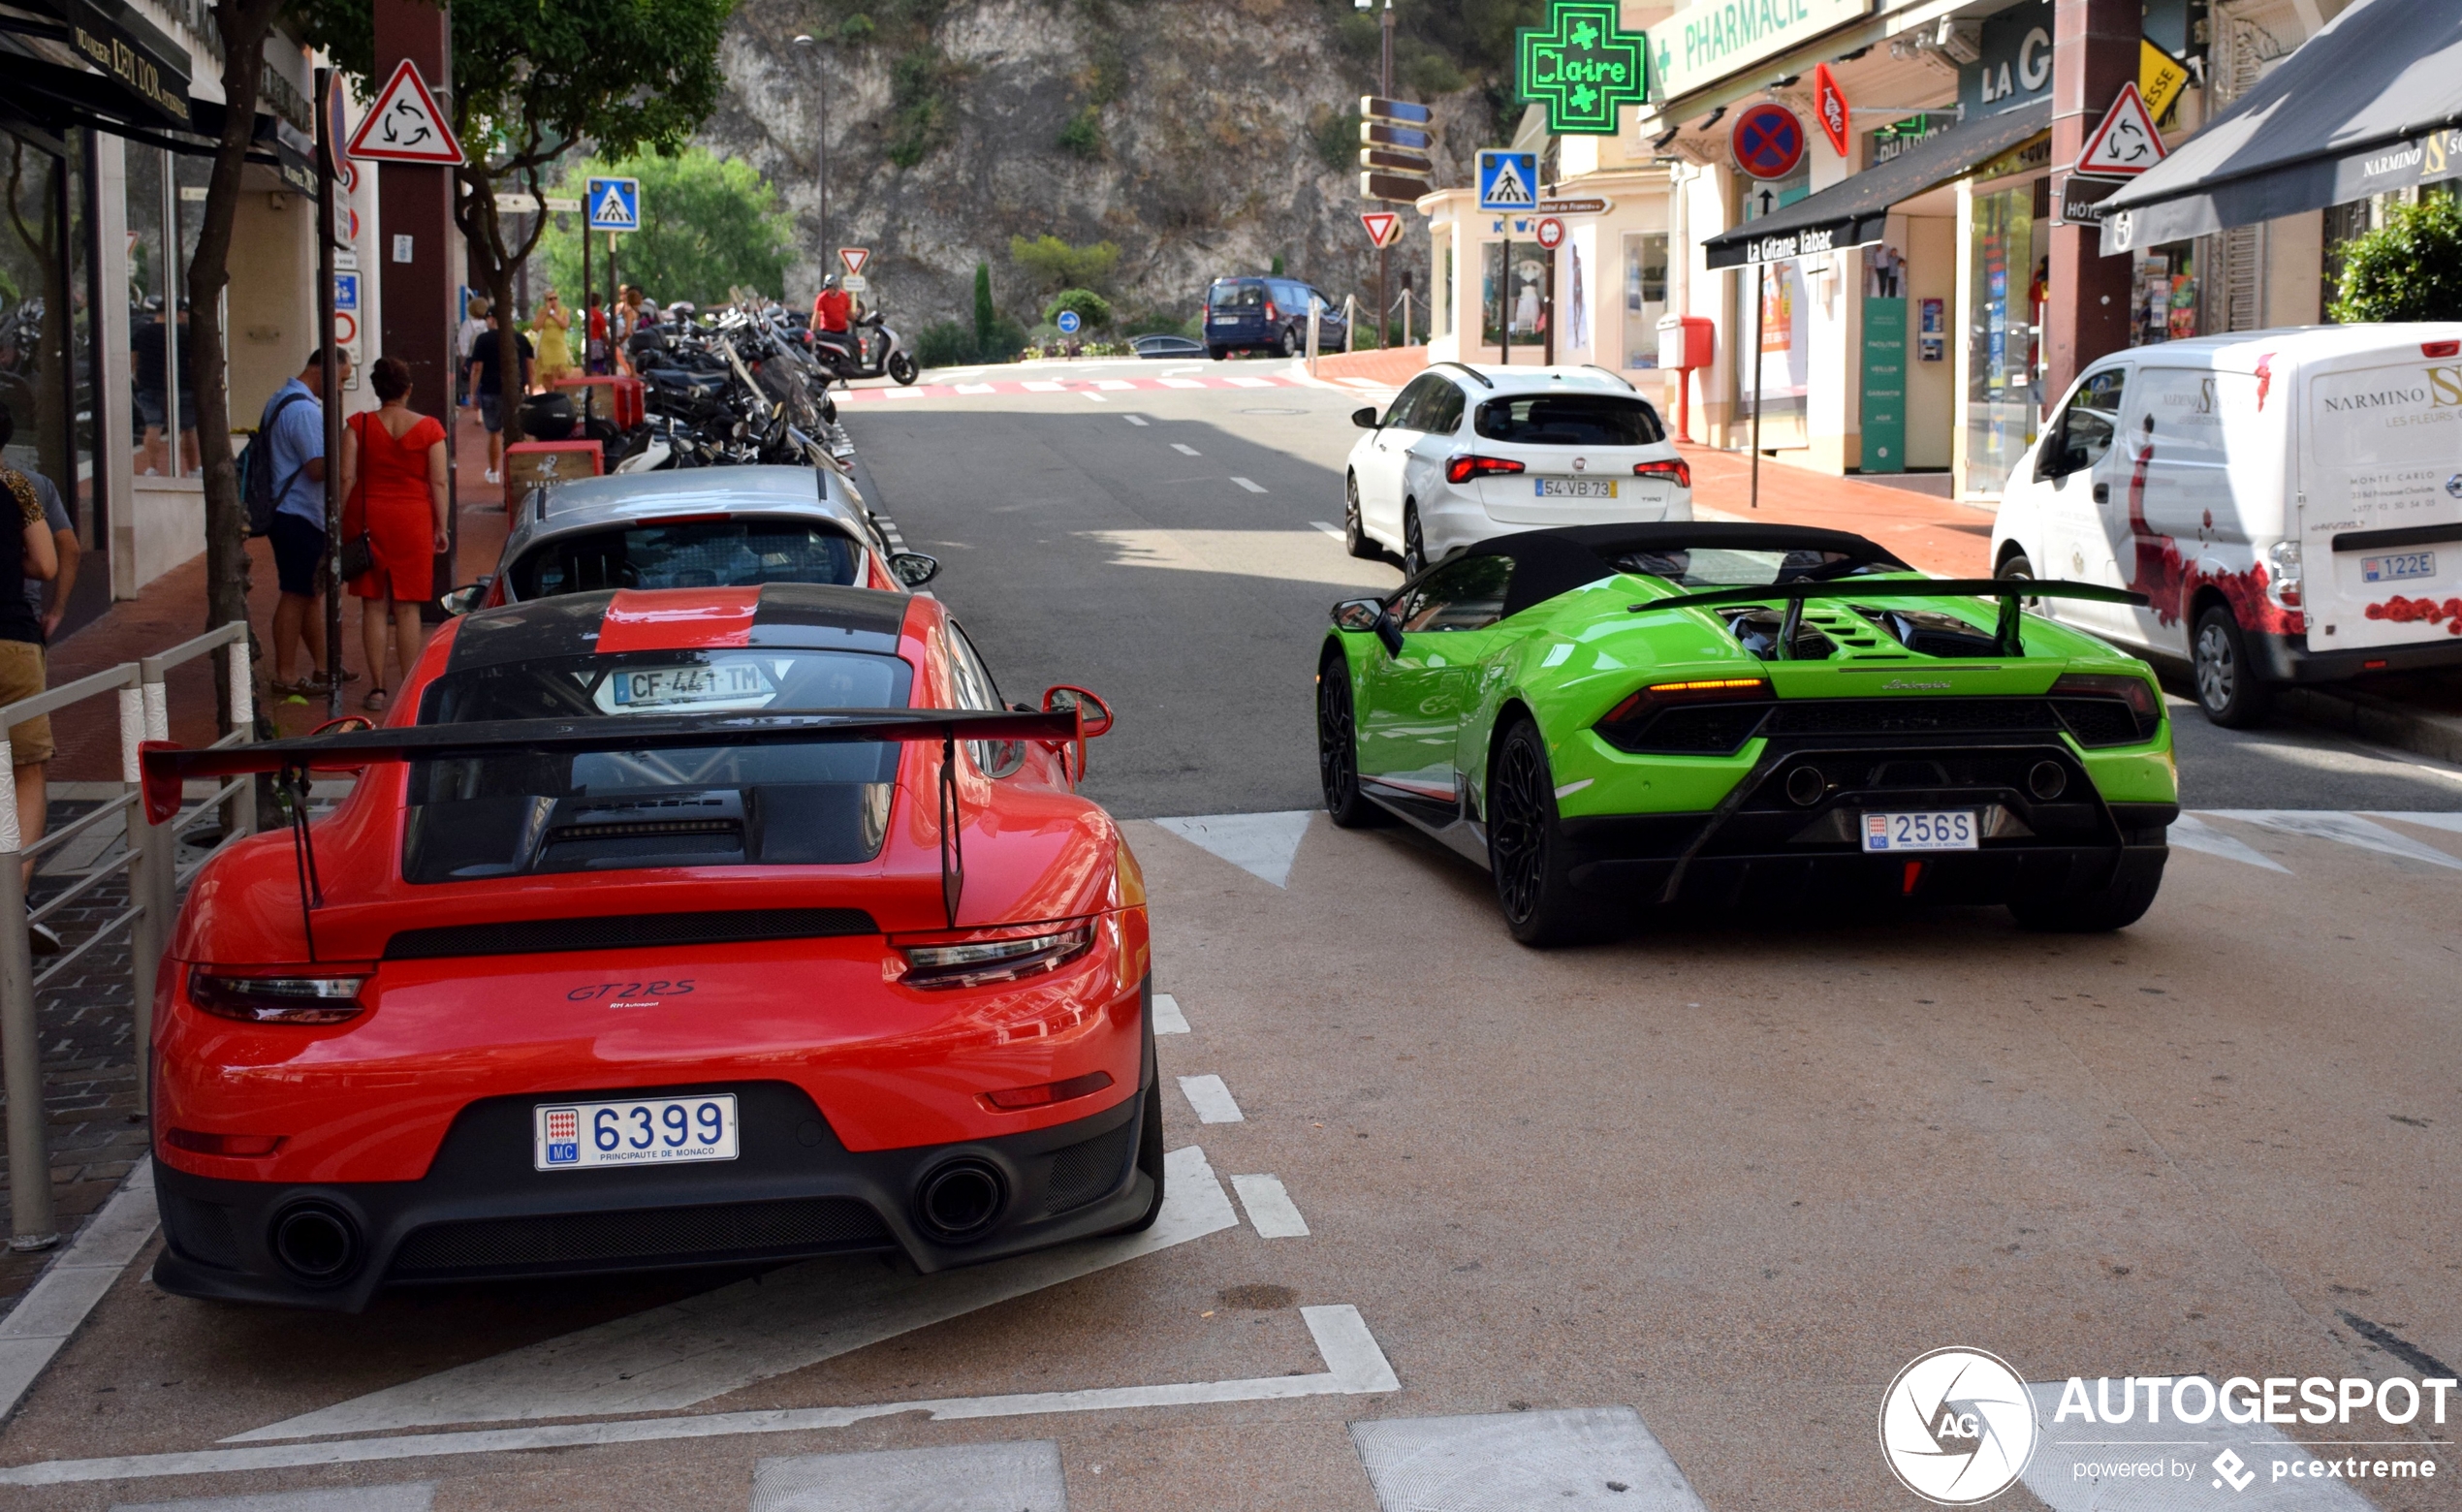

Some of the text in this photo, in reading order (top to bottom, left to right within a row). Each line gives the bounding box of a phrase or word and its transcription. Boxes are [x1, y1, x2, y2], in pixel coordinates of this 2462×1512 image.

[1538, 49, 1626, 82] Claire
[1981, 27, 2052, 103] LA G
[2143, 68, 2174, 111] ESSE
[1823, 87, 1843, 133] TABAC
[2363, 147, 2421, 177] NARMINO
[2448, 136, 2462, 155] S
[2067, 201, 2102, 219] HÔTE
[1747, 228, 1833, 263] La Gitane Tabac
[2324, 388, 2425, 412] NARMINO
[2384, 416, 2407, 427] LES
[2410, 411, 2454, 425] FLEURS
[2385, 554, 2431, 575] 122E
[1873, 837, 1885, 846] MC
[1895, 814, 1969, 842] 256S
[594, 1102, 722, 1151] 6399
[553, 1145, 574, 1159] MC
[600, 1151, 657, 1161] PRINCIPAUTE
[677, 1148, 715, 1156] MONACO
